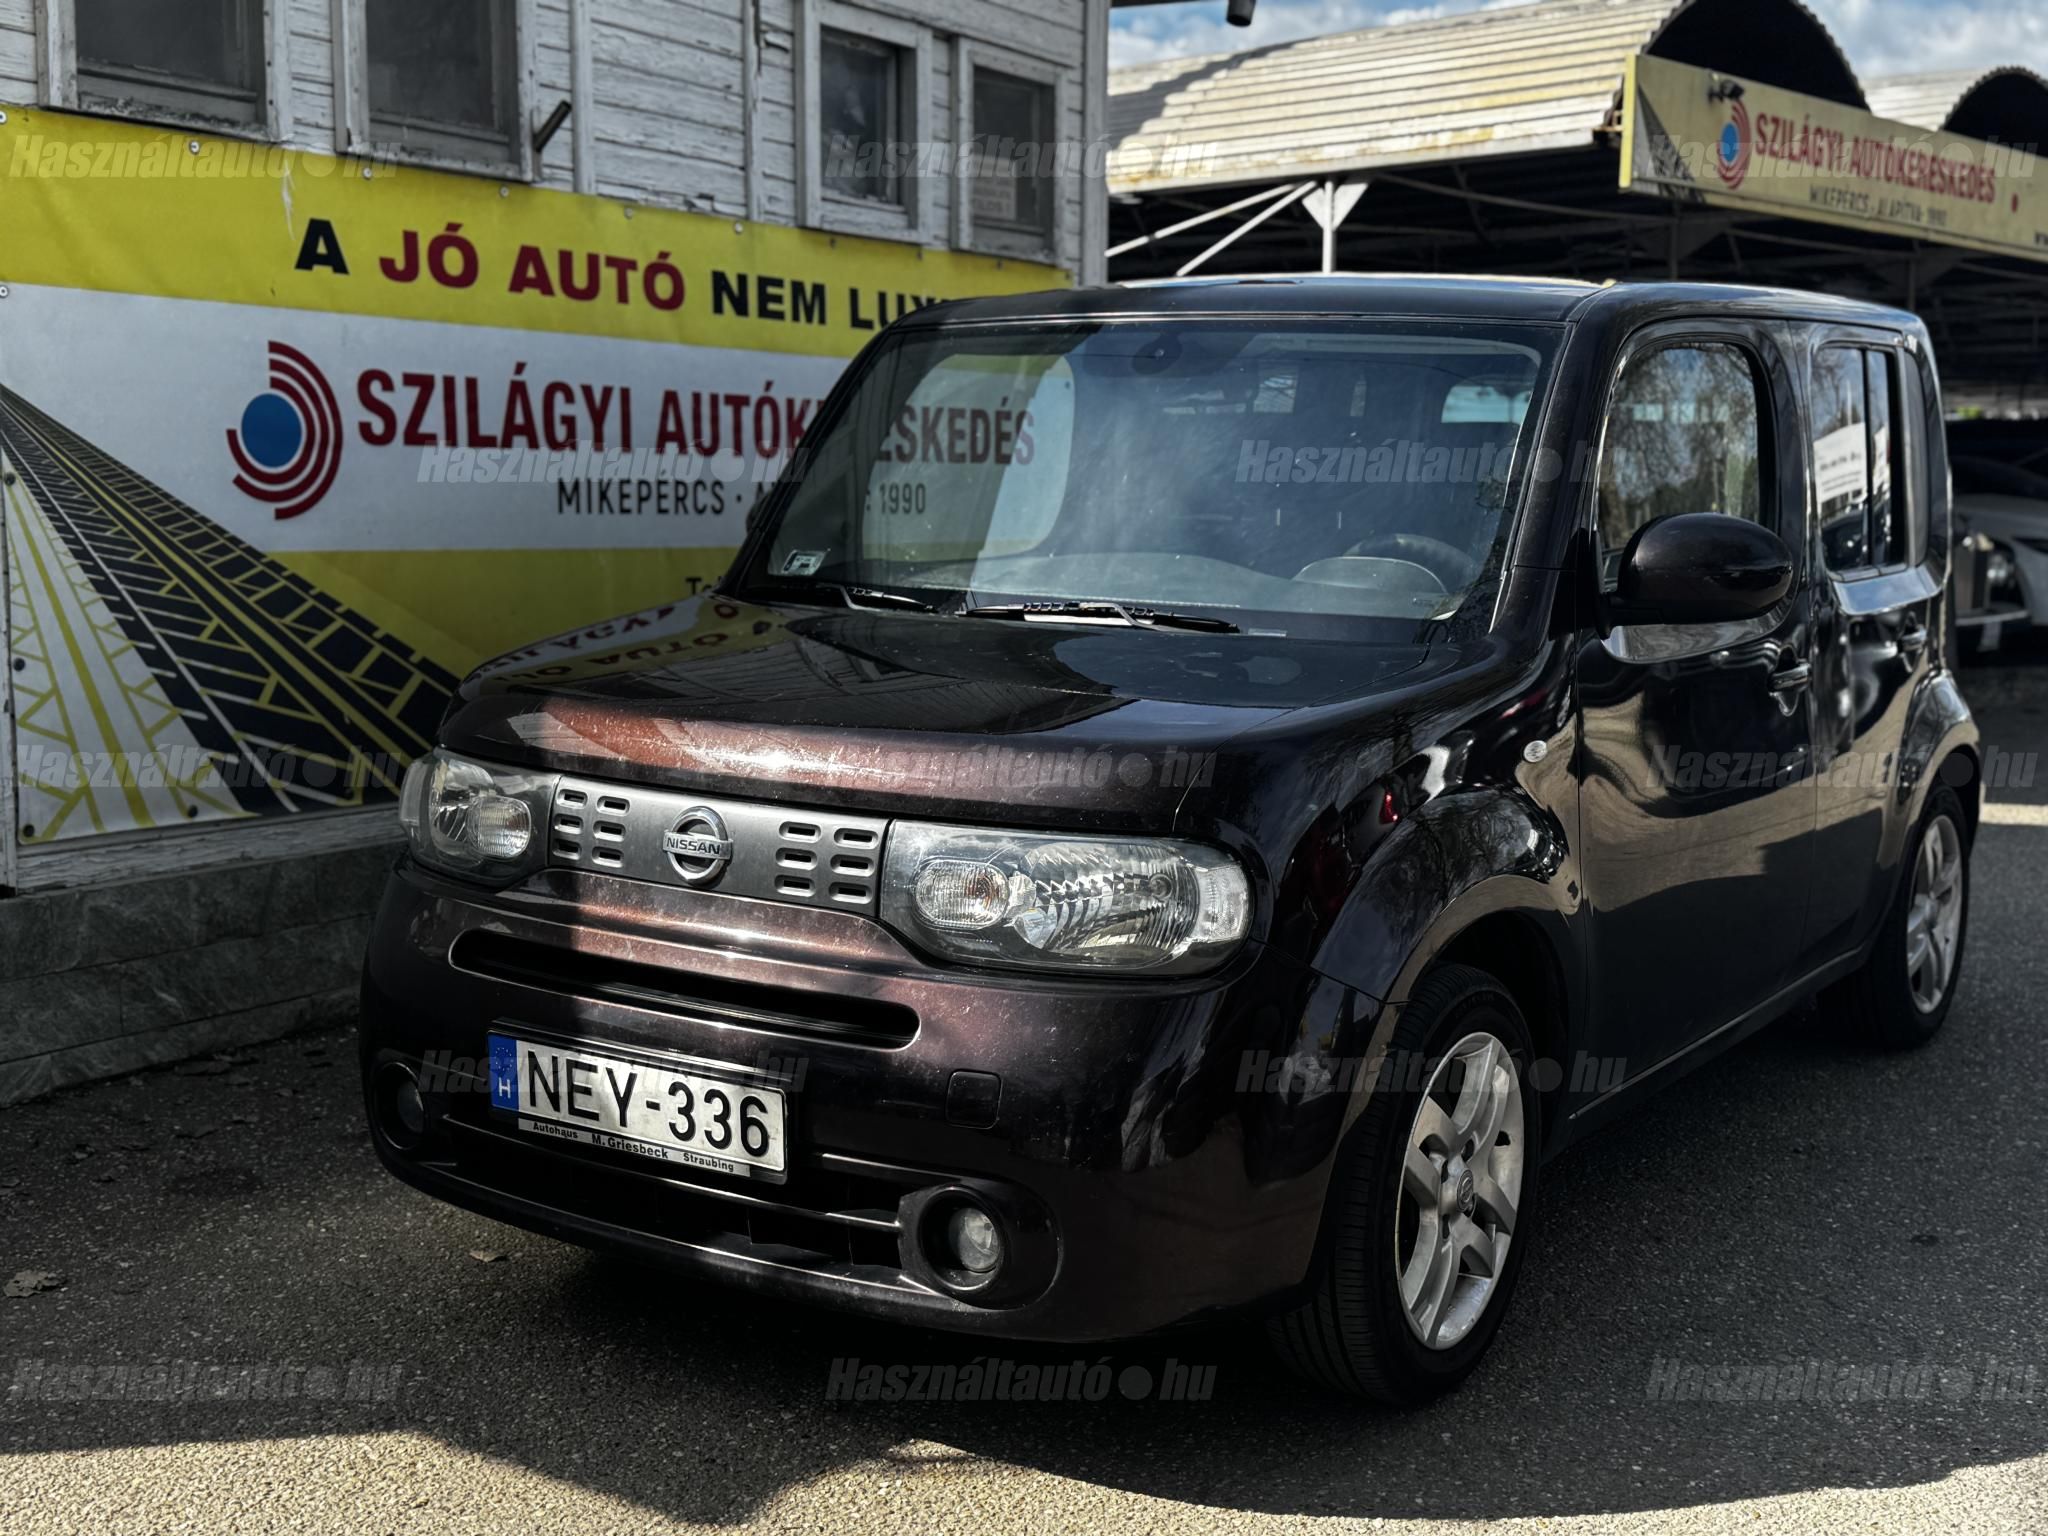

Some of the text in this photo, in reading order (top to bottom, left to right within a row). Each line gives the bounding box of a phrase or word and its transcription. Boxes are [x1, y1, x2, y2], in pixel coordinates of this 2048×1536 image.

[295, 218, 349, 275] A
[380, 222, 479, 289] JÓ
[508, 246, 686, 311] AUTÓ
[711, 270, 827, 326] NEM
[357, 361, 632, 455] SZILÁGYI
[557, 470, 725, 515] MIKEPÉRCS
[666, 837, 721, 855] NISSAN
[498, 1049, 771, 1158] H NEY-336
[532, 1121, 578, 1140] Autohaus
[683, 1151, 735, 1173] Straubing
